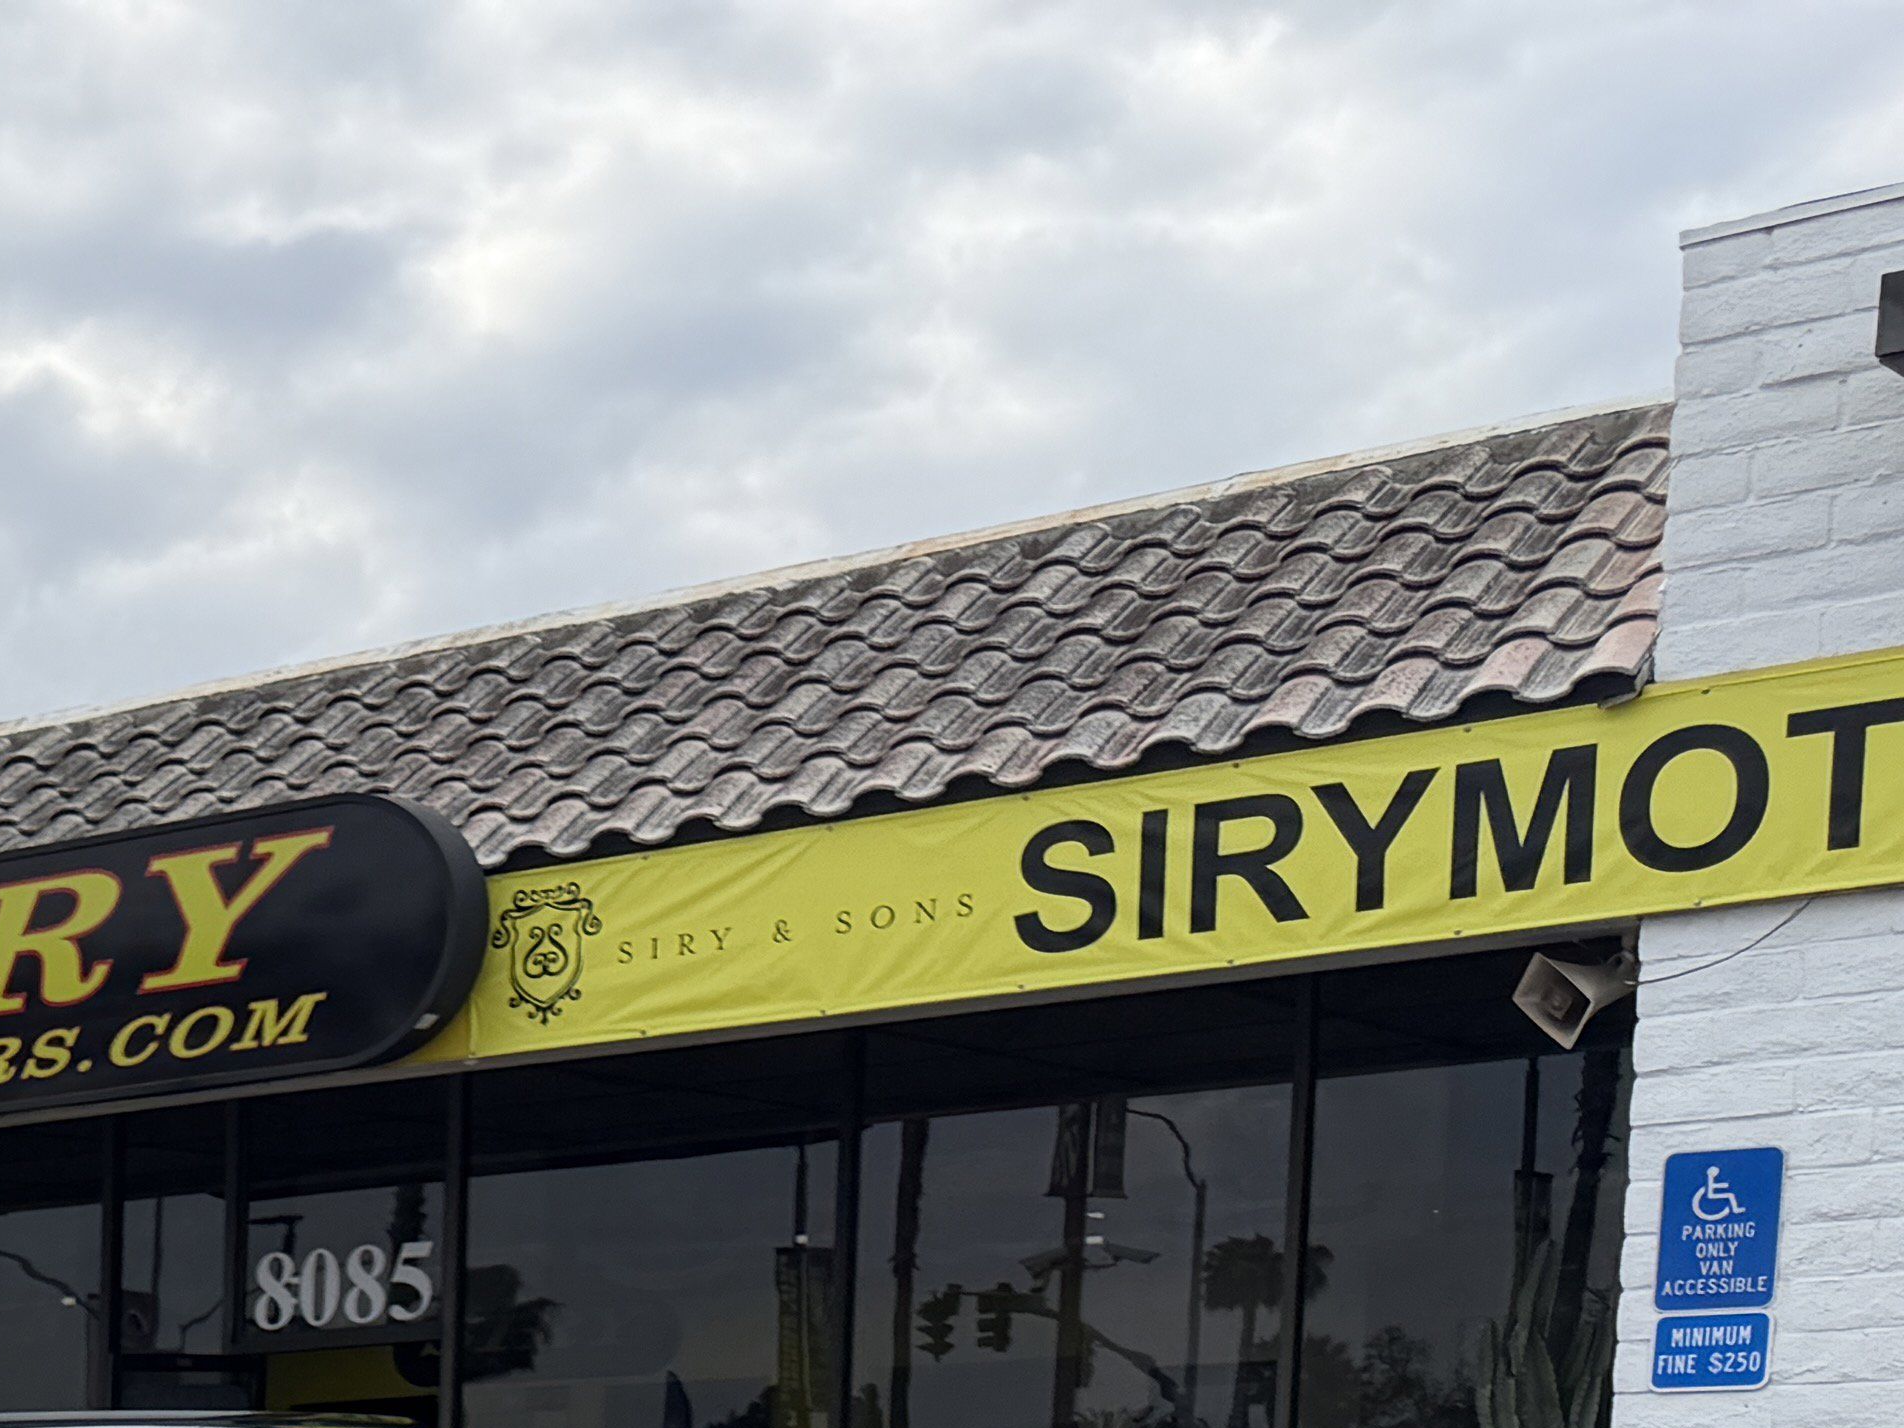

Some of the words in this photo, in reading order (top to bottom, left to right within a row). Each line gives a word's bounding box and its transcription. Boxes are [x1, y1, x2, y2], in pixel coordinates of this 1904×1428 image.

[617, 926, 735, 965] SIRY
[772, 918, 794, 945] &
[835, 892, 975, 935] SONS
[1012, 698, 1904, 956] SIRYMOT
[1681, 1221, 1756, 1241] PARKING
[1695, 1241, 1739, 1259] ONLY
[1699, 1260, 1734, 1276] VAN
[254, 1240, 435, 1332] 8085
[1661, 1275, 1768, 1297] ACCESSIBLE
[1670, 1324, 1753, 1349] MINIMUM
[1656, 1353, 1698, 1376] FINE
[1707, 1350, 1762, 1375] $250
